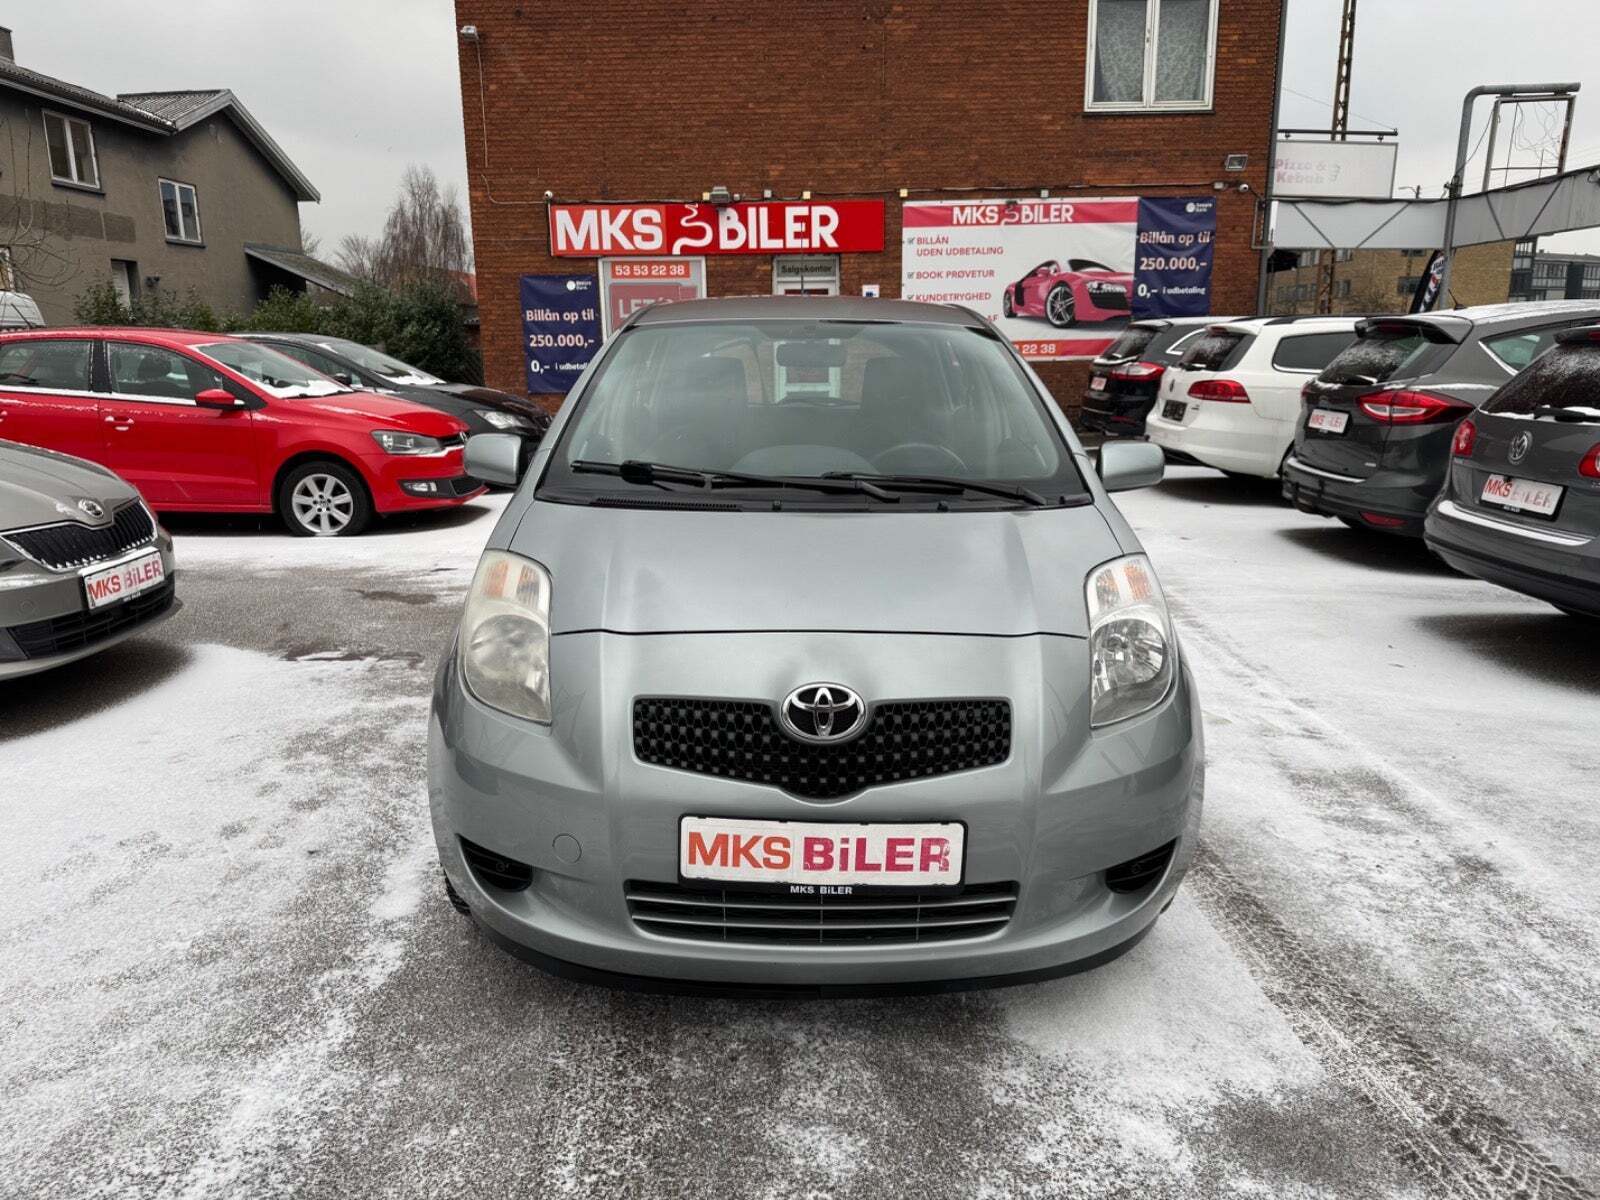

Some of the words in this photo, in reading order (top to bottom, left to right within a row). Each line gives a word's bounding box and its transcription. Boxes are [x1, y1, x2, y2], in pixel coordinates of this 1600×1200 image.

[952, 206, 998, 225] MKS
[1021, 204, 1074, 223] BILER
[555, 208, 662, 251] MKS
[718, 205, 840, 249] BILER
[916, 235, 949, 245] BILLÅN
[1139, 231, 1175, 244] Billån
[1178, 234, 1194, 246] op
[1198, 231, 1210, 243] til
[916, 248, 943, 257] UDEN
[945, 246, 1004, 256] UDBETALING
[615, 264, 631, 276] 53
[633, 264, 649, 276] 53
[651, 264, 666, 276] 22
[669, 264, 685, 276] 38
[781, 264, 833, 275] Salgskontor
[1139, 257, 1207, 272] 250.000,-
[916, 271, 943, 280] BOOK
[946, 269, 995, 279] PRØVETUR
[916, 292, 992, 302] KUNDETRYGHED
[1137, 283, 1158, 299] 0,-
[1167, 286, 1206, 295] udbetaling
[526, 308, 560, 321] Billån
[563, 311, 579, 324] op
[581, 308, 595, 321] til
[529, 334, 595, 349] 250.000,-
[1022, 343, 1038, 354] 22
[1040, 343, 1056, 354] 38
[530, 359, 550, 375] 0,-
[1484, 479, 1512, 498] MKS
[87, 575, 121, 600] MKS
[688, 831, 791, 870] MKS
[803, 837, 949, 873] BiLER
[790, 885, 815, 895] MKS
